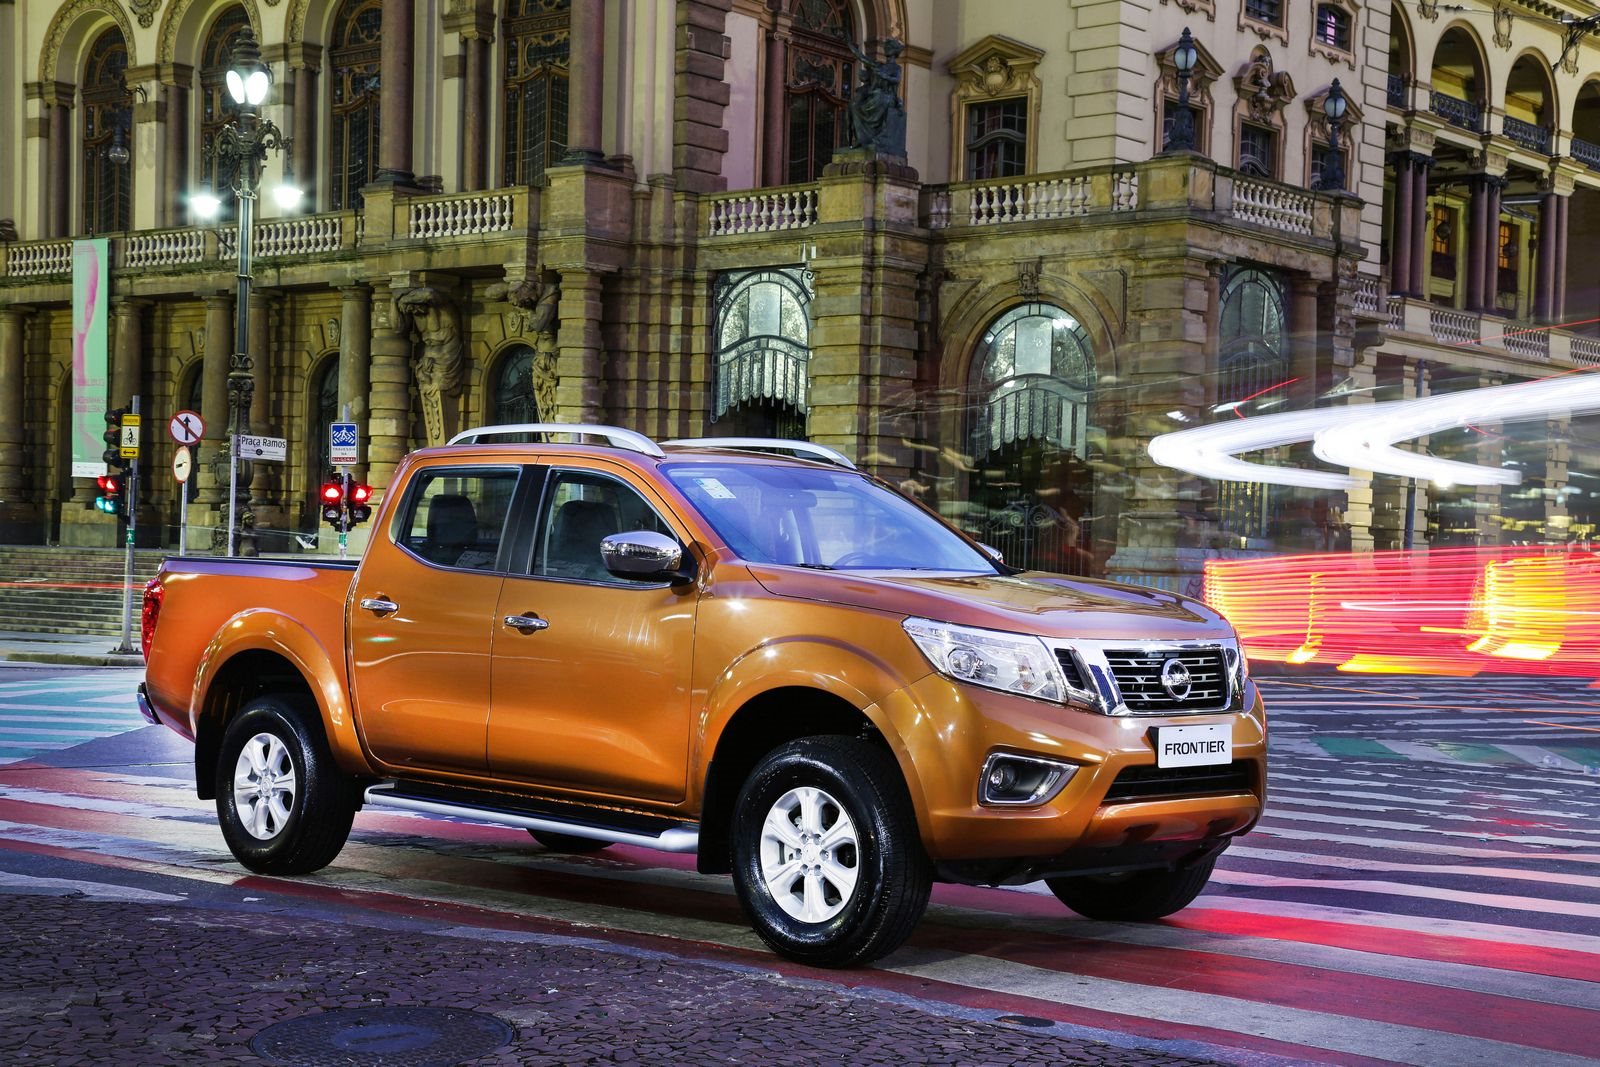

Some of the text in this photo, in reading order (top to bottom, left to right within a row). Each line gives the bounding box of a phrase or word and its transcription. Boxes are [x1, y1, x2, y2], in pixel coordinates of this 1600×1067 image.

[241, 436, 286, 449] Praça Ramos
[1164, 740, 1226, 756] FRONTIER
